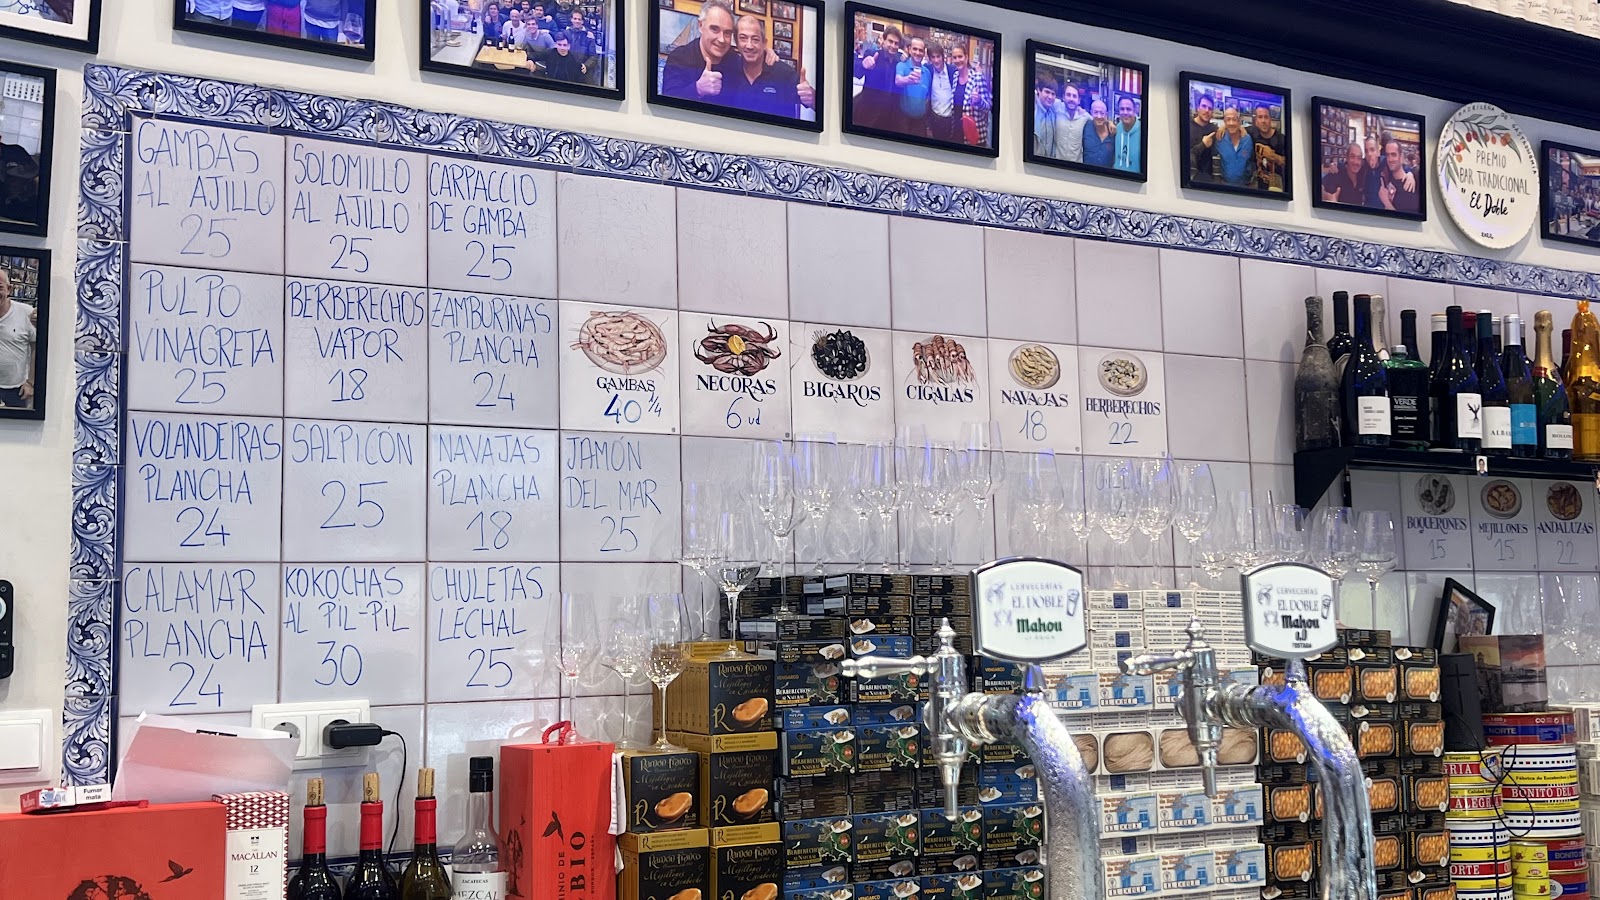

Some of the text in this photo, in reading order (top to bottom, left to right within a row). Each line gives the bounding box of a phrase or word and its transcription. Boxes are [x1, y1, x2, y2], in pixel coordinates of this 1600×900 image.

[137, 121, 259, 174] GAMBAS
[1476, 149, 1507, 169] PREMIO
[293, 143, 411, 194] SOLOMILLO
[429, 161, 538, 206] CARPACCIO
[1459, 167, 1531, 196] BAR TRADICIONAL
[137, 171, 275, 216] AL AJILLO
[292, 190, 410, 234] AL AJILLO
[429, 201, 527, 239] DE GAMBA
[180, 213, 237, 258] 25
[329, 235, 373, 273] 25
[465, 240, 516, 281] 25
[140, 270, 242, 318] PULPO
[287, 281, 425, 327] BERBERECHOS
[135, 320, 275, 368] VINAGRETA
[314, 327, 404, 363] VAPOR
[443, 331, 539, 368] PLANCHA
[175, 368, 227, 405] 25
[328, 368, 368, 402] 18
[473, 371, 515, 411] 24
[596, 376, 656, 394] GAMBAS
[696, 375, 776, 402] NECORAS
[803, 381, 881, 408] BIGAROS
[906, 384, 974, 405] CIGALAS
[1000, 389, 1069, 408] NAVAJAS
[603, 393, 642, 424] 40
[726, 397, 743, 429] 6
[1019, 409, 1047, 441] 18
[1085, 397, 1161, 419] BERBERECHOS
[132, 419, 281, 463] VOLANDEIRAS
[292, 424, 413, 466] SALPICÓN
[439, 434, 540, 464] NAVAJAS
[1108, 422, 1139, 445] 22
[566, 436, 642, 472] JAMÓN
[138, 463, 252, 505] PLANCHA
[433, 469, 540, 505] PLANCHA
[563, 476, 662, 515] DEL MAR
[320, 480, 388, 530] 25
[176, 506, 230, 547] 24
[466, 510, 512, 551] 18
[600, 515, 641, 552] 25
[1407, 516, 1467, 535] BOQUERONES
[1479, 522, 1528, 540] MEJILLONES
[1537, 522, 1594, 535] ANDALUZAS
[1427, 538, 1447, 560] 15
[1494, 538, 1515, 561] 15
[1556, 540, 1579, 564] 22
[124, 566, 265, 615] CALAMAR
[285, 565, 404, 600] KOKOCHAS
[430, 565, 543, 603] CHULETAS
[283, 602, 308, 634] AL
[1012, 595, 1064, 609] EL DOBLE
[1278, 600, 1319, 611] EL DOBLE
[438, 607, 527, 642] LECHAL
[1016, 617, 1063, 633] Mahou
[1281, 615, 1320, 629] Mahou
[124, 618, 268, 662] PLANCHA
[315, 640, 363, 686] 30
[466, 647, 515, 688] 25
[169, 661, 224, 707] 24
[1488, 727, 1517, 735] NORTE
[1455, 797, 1501, 809] ALEGRA
[1511, 786, 1571, 798] BONITO DEL
[231, 850, 278, 861] MACALLAN
[249, 864, 259, 873] 12
[558, 851, 565, 867] DE
[1451, 863, 1480, 875] ORTE
[1554, 852, 1578, 860] BONITO
